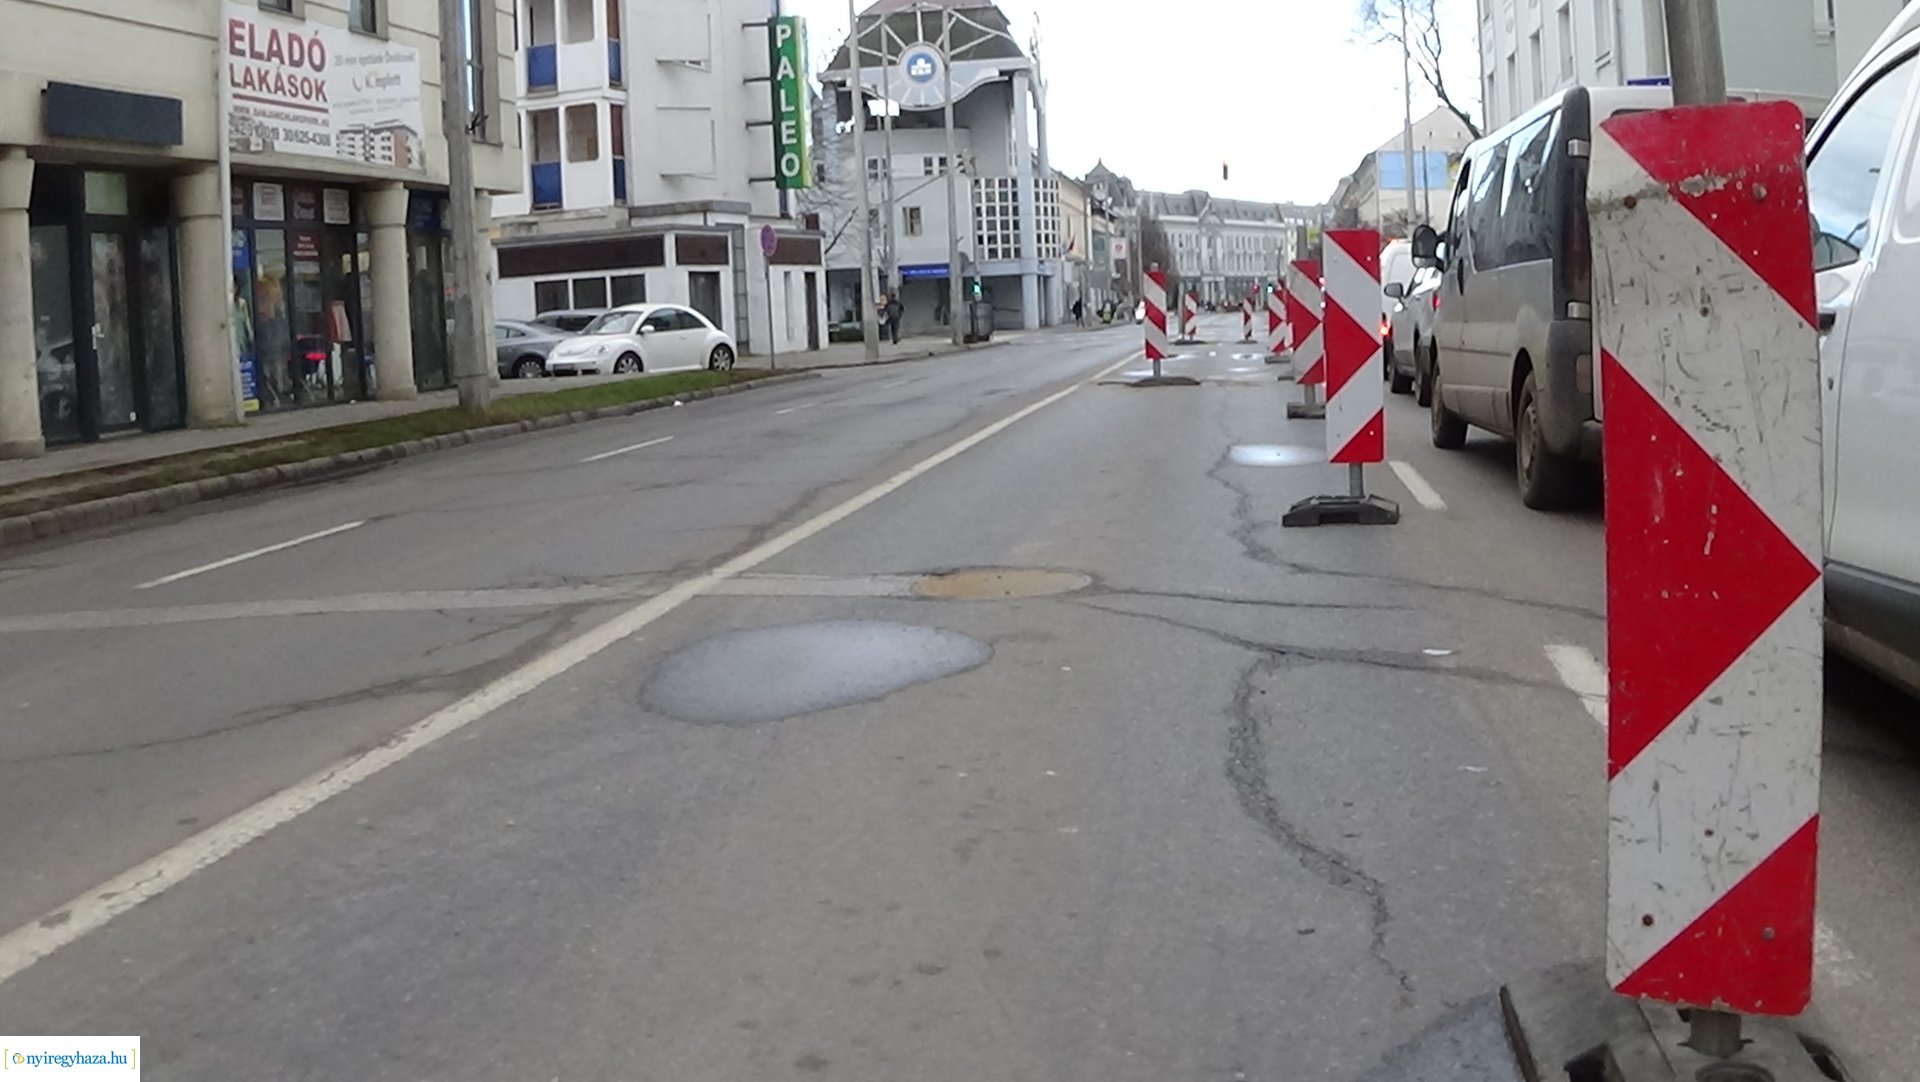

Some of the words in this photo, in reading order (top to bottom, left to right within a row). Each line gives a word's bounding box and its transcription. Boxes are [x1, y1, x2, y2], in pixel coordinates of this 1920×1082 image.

[228, 18, 326, 73] ELADÓ
[229, 63, 329, 103] LAKÁSOK
[775, 23, 801, 178] PALEO
